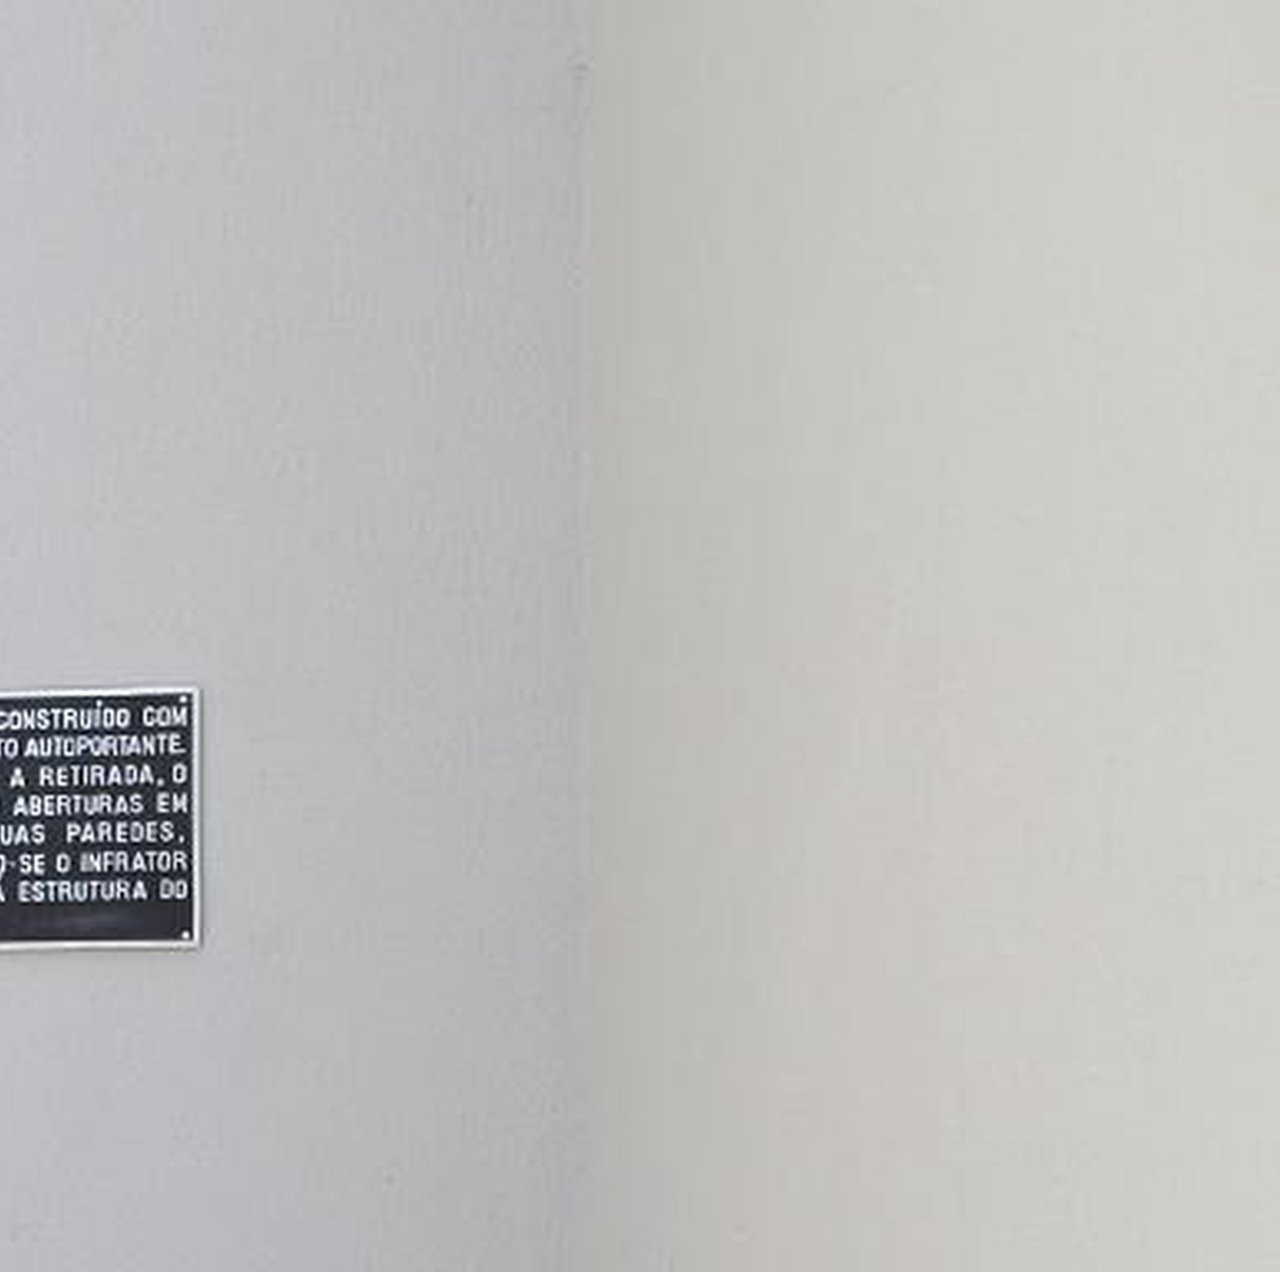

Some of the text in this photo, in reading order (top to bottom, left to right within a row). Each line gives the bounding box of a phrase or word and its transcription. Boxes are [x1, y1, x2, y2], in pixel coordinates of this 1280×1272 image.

[143, 706, 187, 728] COM
[10, 767, 26, 788] A
[172, 763, 187, 784] O
[13, 793, 144, 816] ABERTURAS
[157, 792, 188, 814] EM
[56, 852, 71, 873] O
[80, 850, 188, 873] INFRATOR
[18, 880, 147, 902] ESTRUTURA
[159, 878, 188, 900] DO
